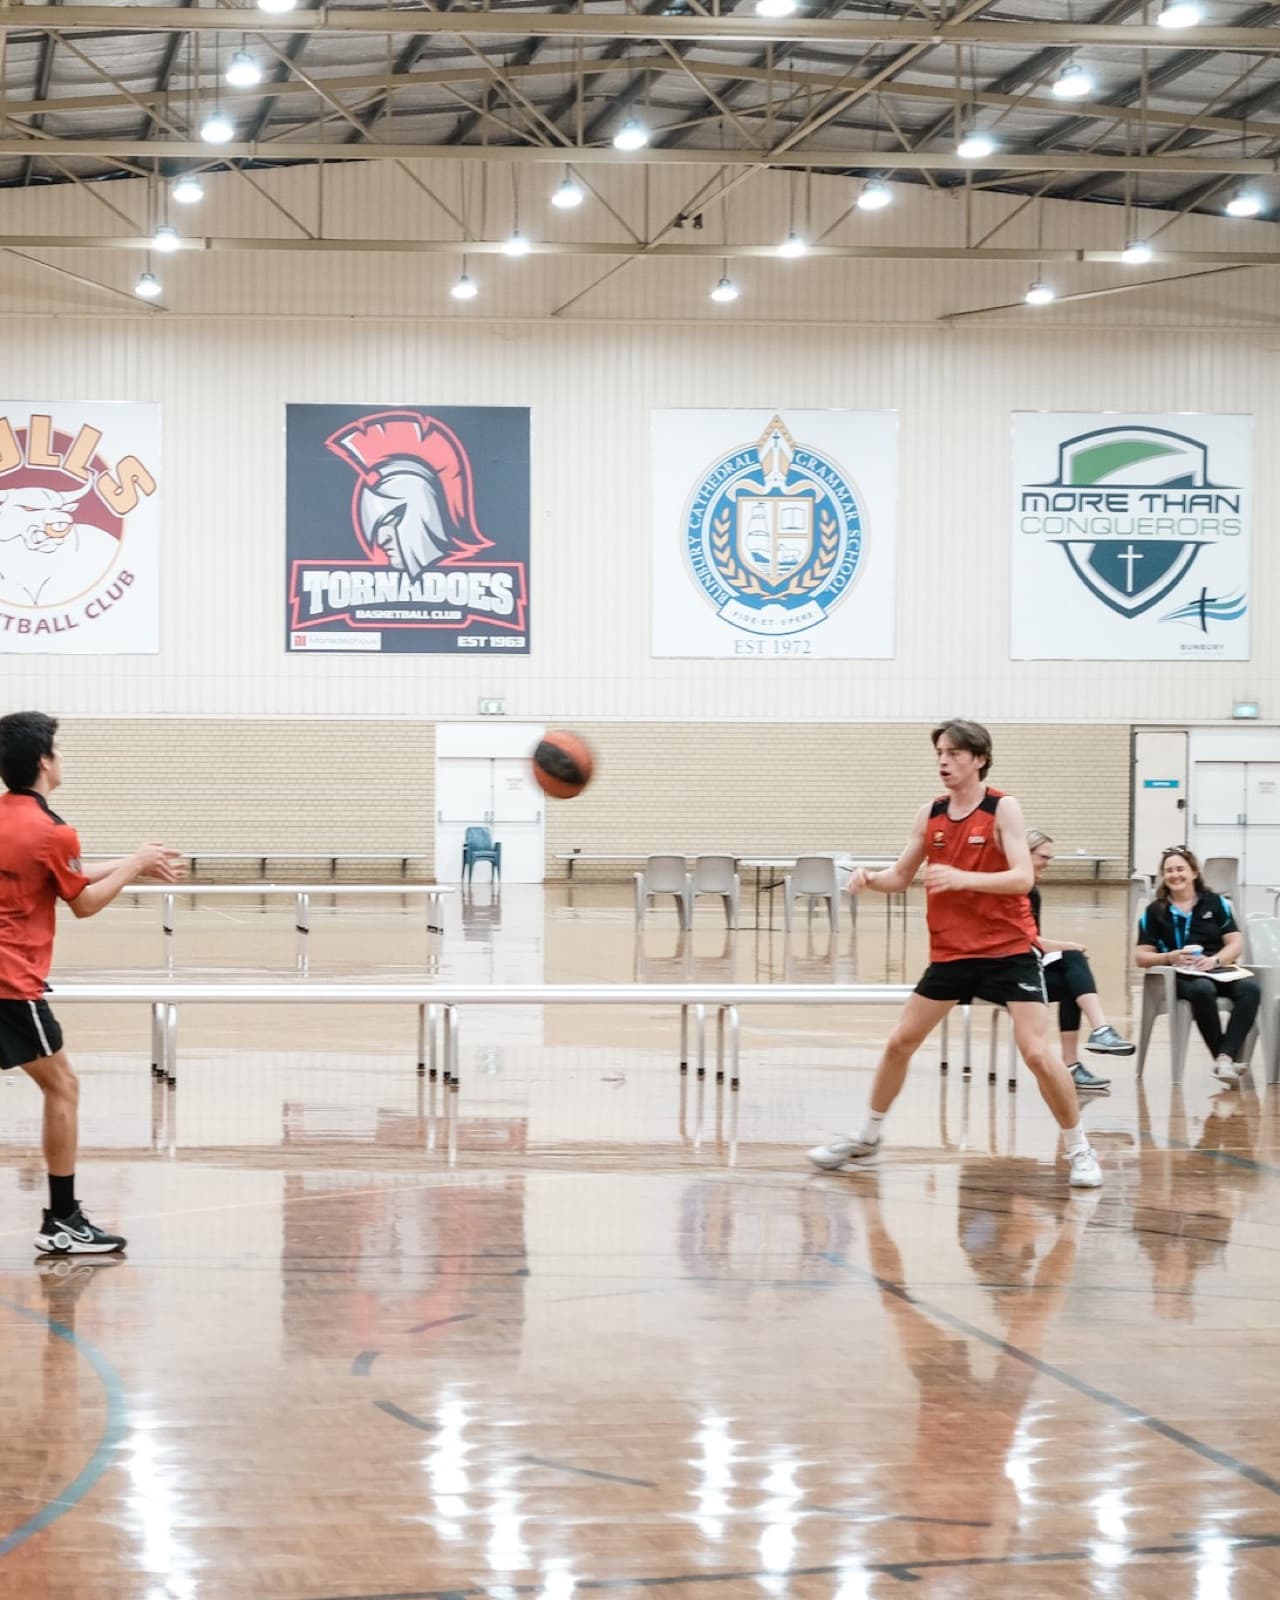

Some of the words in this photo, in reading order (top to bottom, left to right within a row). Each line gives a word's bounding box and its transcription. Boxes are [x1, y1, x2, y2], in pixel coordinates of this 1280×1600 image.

[688, 452, 755, 529] CATHEDRAL
[795, 452, 858, 521] GRAMMAR
[1021, 492, 1129, 512] MORE
[1138, 493, 1241, 514] THAN
[1020, 516, 1242, 537] CONQUERORS
[688, 535, 731, 605] BUNBURY
[828, 529, 860, 594] SCHOOL
[84, 570, 136, 619] CLUB
[302, 570, 515, 616] TORNADOES
[355, 609, 431, 619] BASKETBALL
[431, 610, 462, 620] CLUB
[457, 635, 489, 648] EST
[734, 639, 766, 654] EST
[773, 639, 812, 654] 1972
